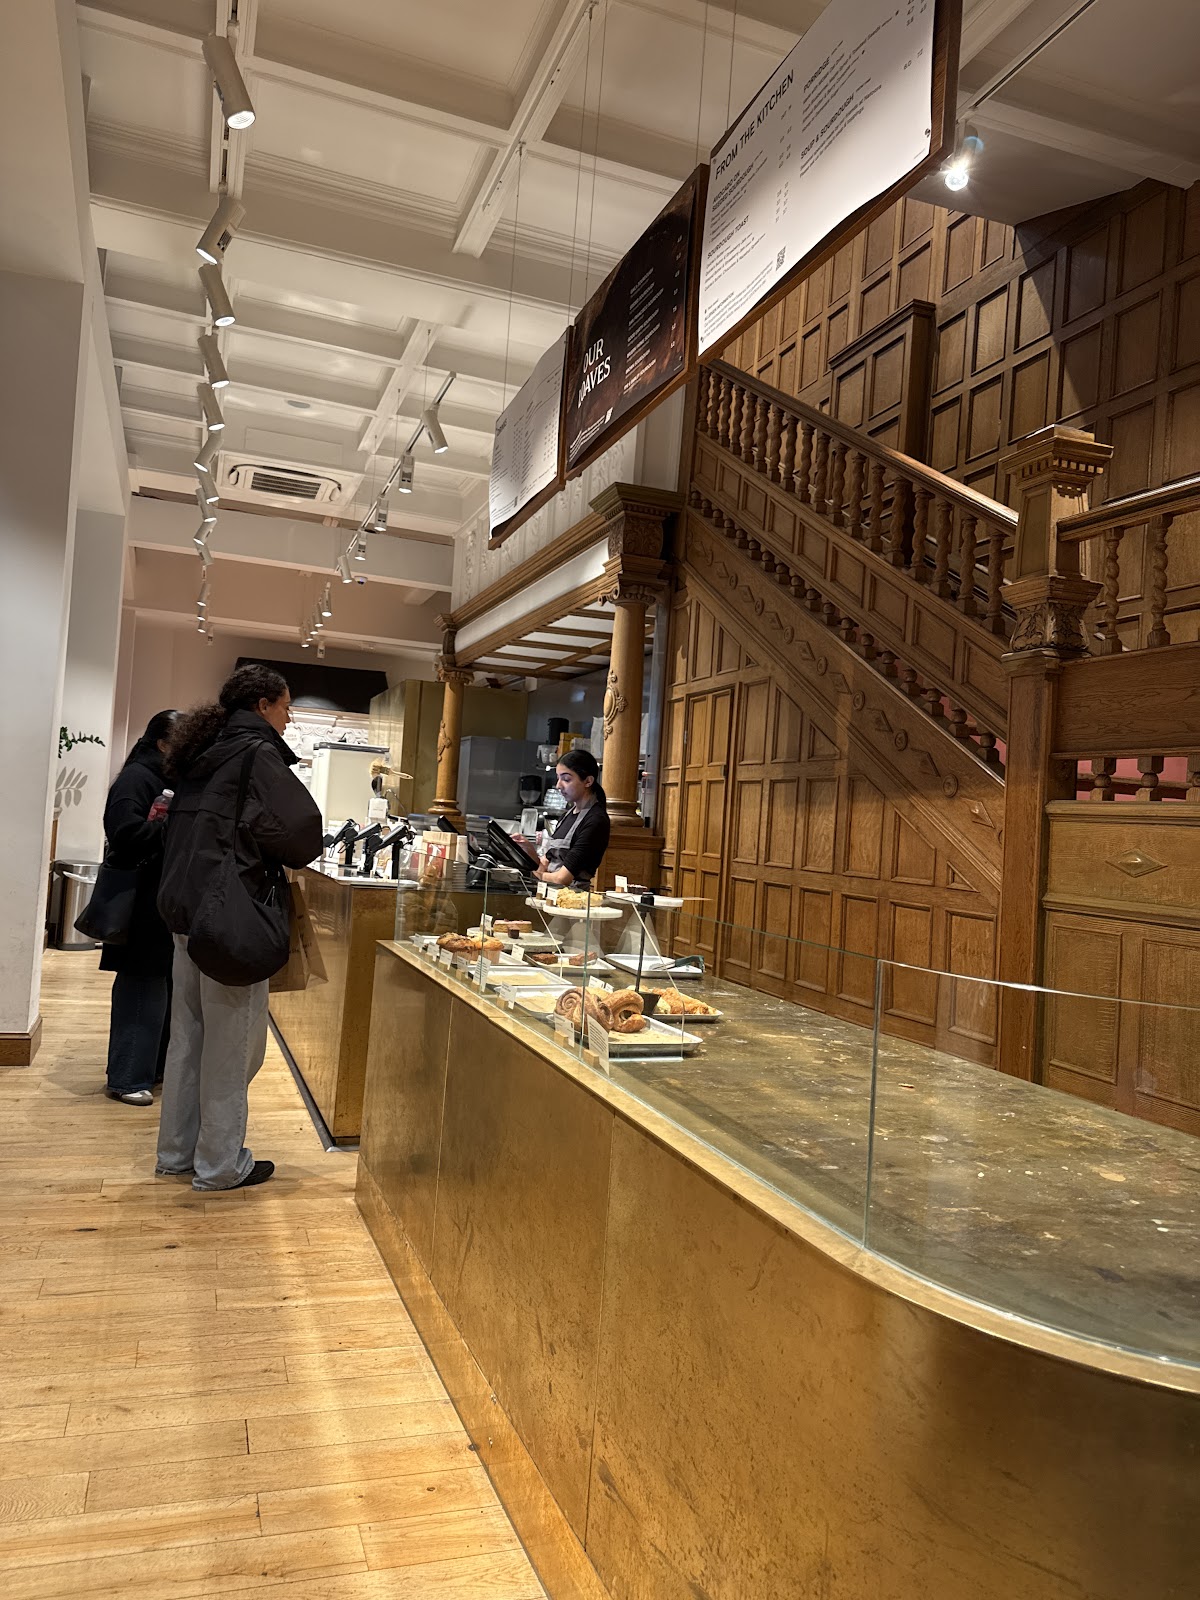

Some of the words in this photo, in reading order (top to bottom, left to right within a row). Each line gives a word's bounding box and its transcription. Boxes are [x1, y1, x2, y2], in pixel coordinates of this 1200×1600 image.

[803, 56, 830, 93] PORRIDGE
[715, 143, 738, 180] FROM
[740, 121, 755, 149] THE
[756, 69, 794, 128] KITCHEN
[800, 138, 815, 160] SOUP
[820, 92, 855, 138] SOURDOUGH
[712, 179, 733, 205] AVOCADO
[728, 162, 754, 196] SOURDOUGH
[707, 230, 735, 259] SOURDOUGH
[734, 214, 750, 234] TOAST
[583, 337, 604, 374] OUR
